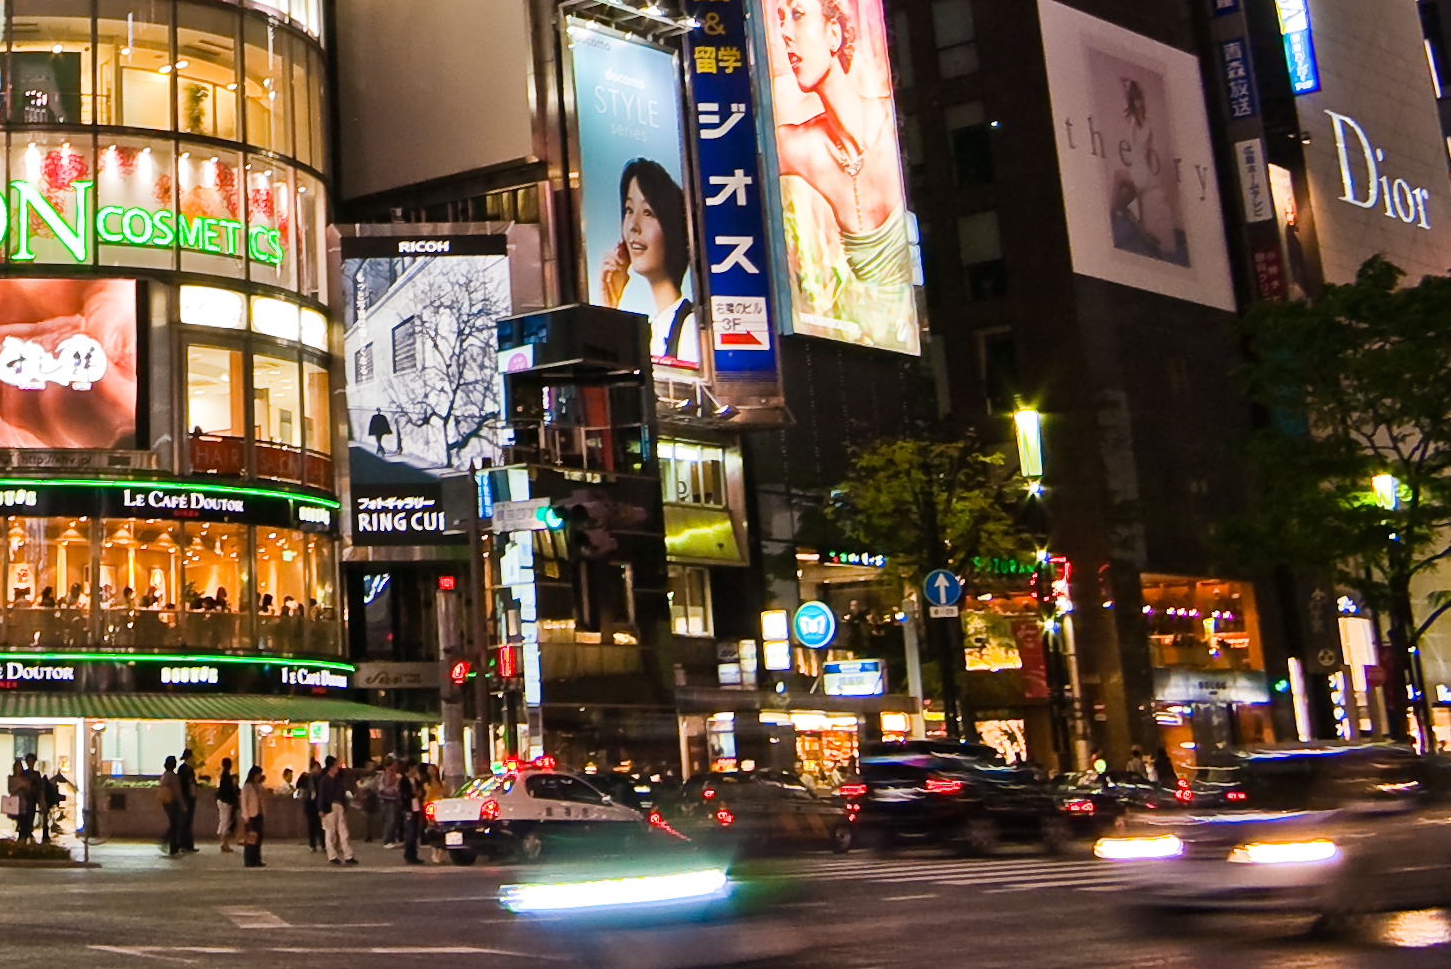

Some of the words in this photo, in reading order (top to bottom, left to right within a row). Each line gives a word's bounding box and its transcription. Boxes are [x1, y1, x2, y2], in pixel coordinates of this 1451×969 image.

[604, 68, 646, 90] docomo
[594, 85, 660, 129] STYLE
[610, 122, 648, 142] series
[1064, 117, 1209, 202] theory
[1324, 109, 1432, 230] Dior
[698, 102, 760, 274] ジオス
[399, 241, 450, 253] RICOH
[722, 318, 742, 331] 3F
[124, 489, 145, 507] LE
[148, 490, 188, 509] CAFÉ
[190, 492, 244, 512] DOUTOR
[358, 512, 407, 532] RING
[6, 662, 74, 681] DOUTOR
